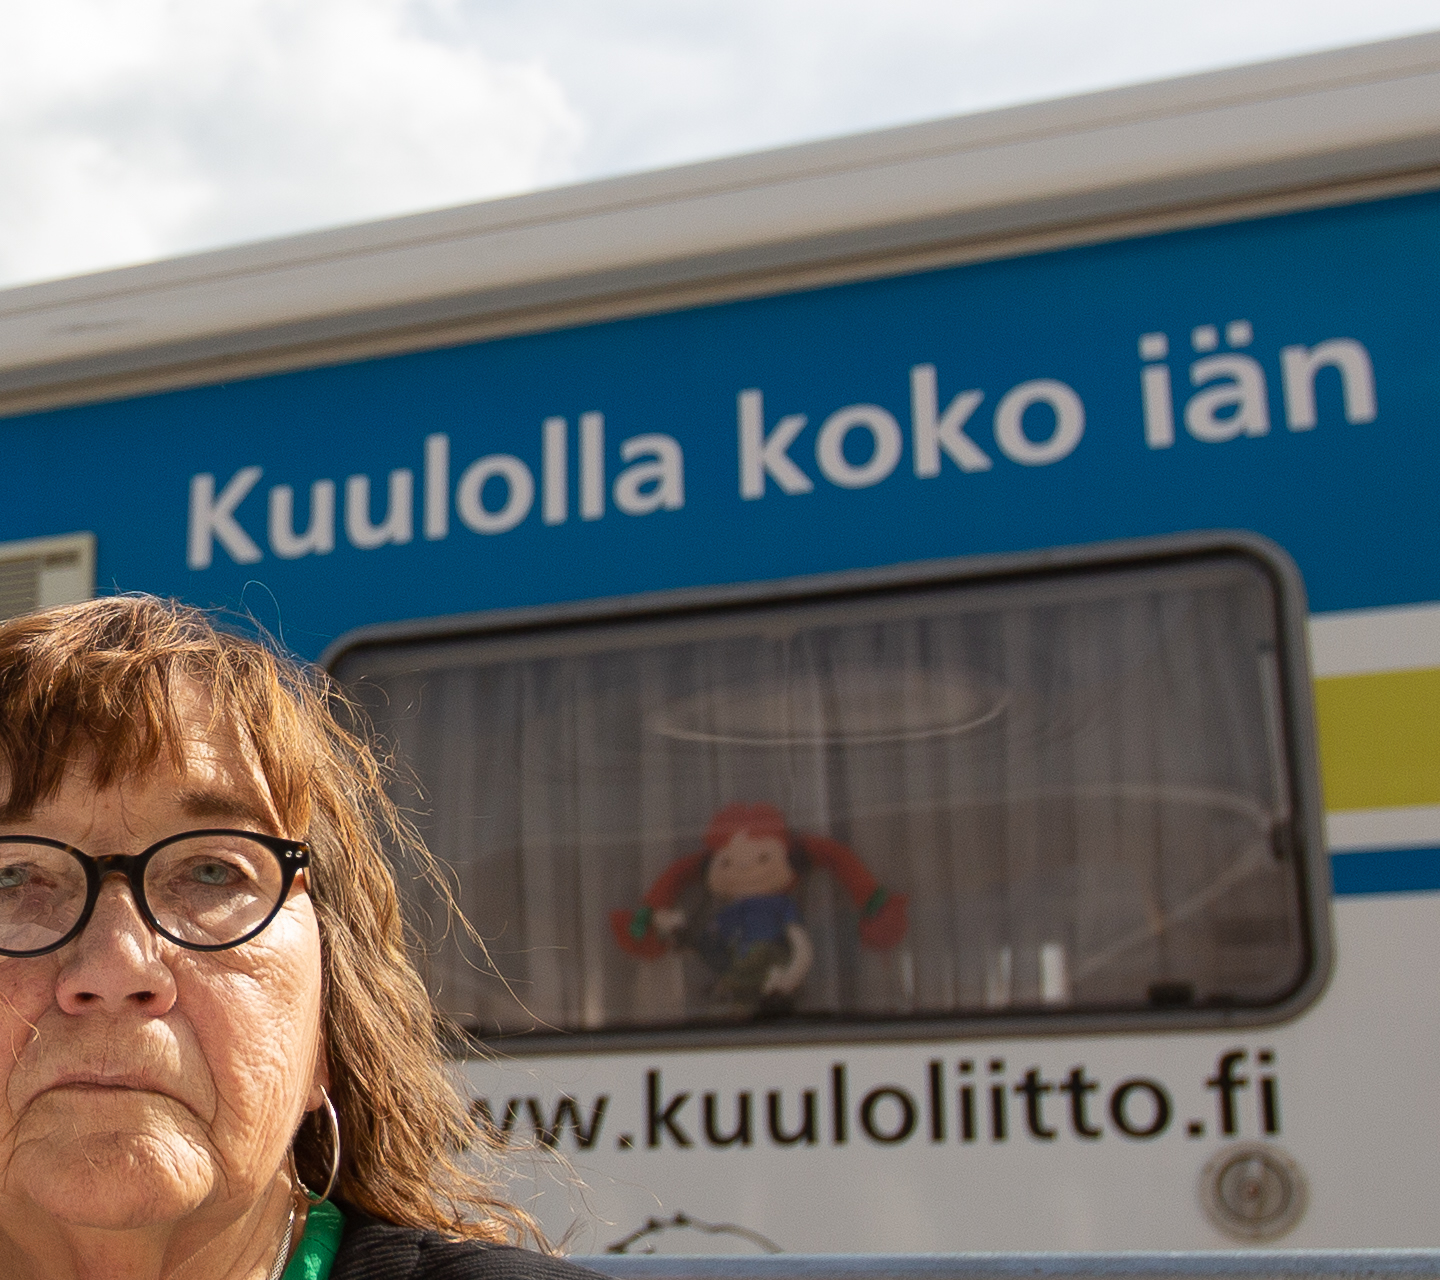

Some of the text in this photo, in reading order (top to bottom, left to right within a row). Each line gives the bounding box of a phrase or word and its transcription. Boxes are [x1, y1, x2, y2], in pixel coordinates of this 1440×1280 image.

[188, 321, 1378, 568] Kuulolla koko iän
